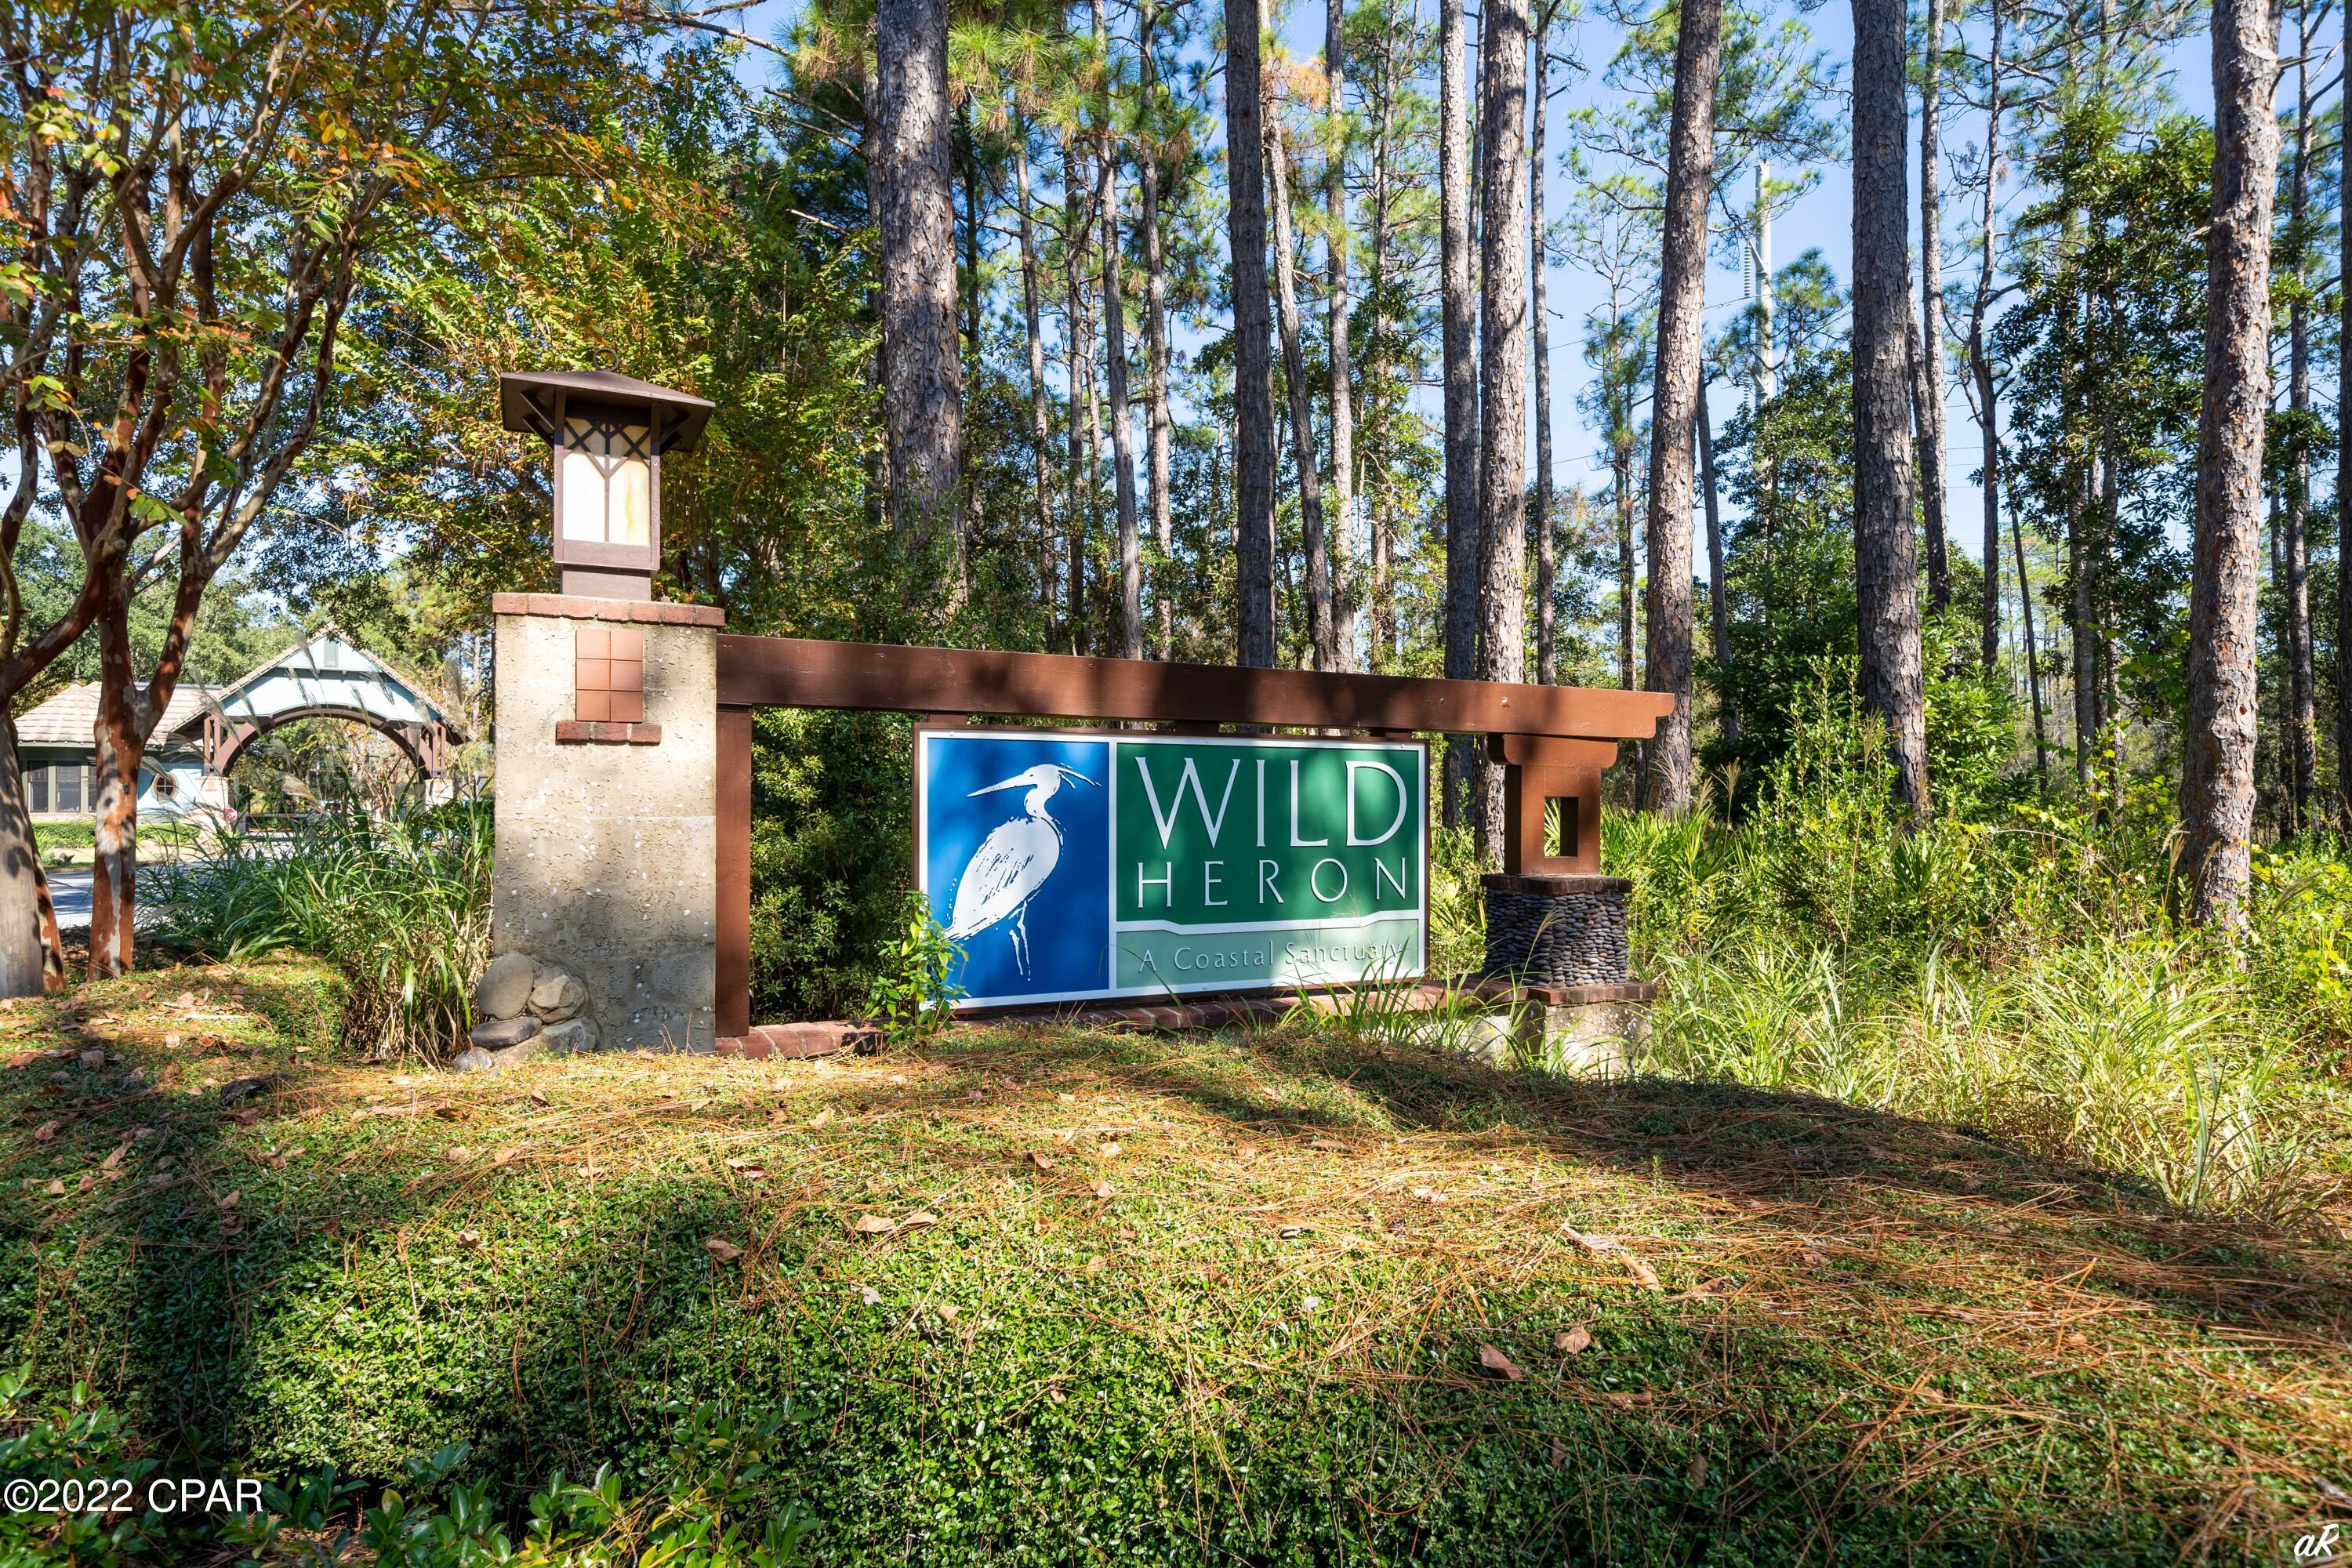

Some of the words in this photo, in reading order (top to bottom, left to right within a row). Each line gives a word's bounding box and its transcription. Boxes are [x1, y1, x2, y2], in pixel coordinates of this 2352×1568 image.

[1134, 757, 1407, 850] WILD
[1138, 857, 1406, 909] HERON
[1138, 949, 1157, 973] A
[1174, 941, 1273, 971] Coastal
[1285, 941, 1403, 965] Sanctuary
